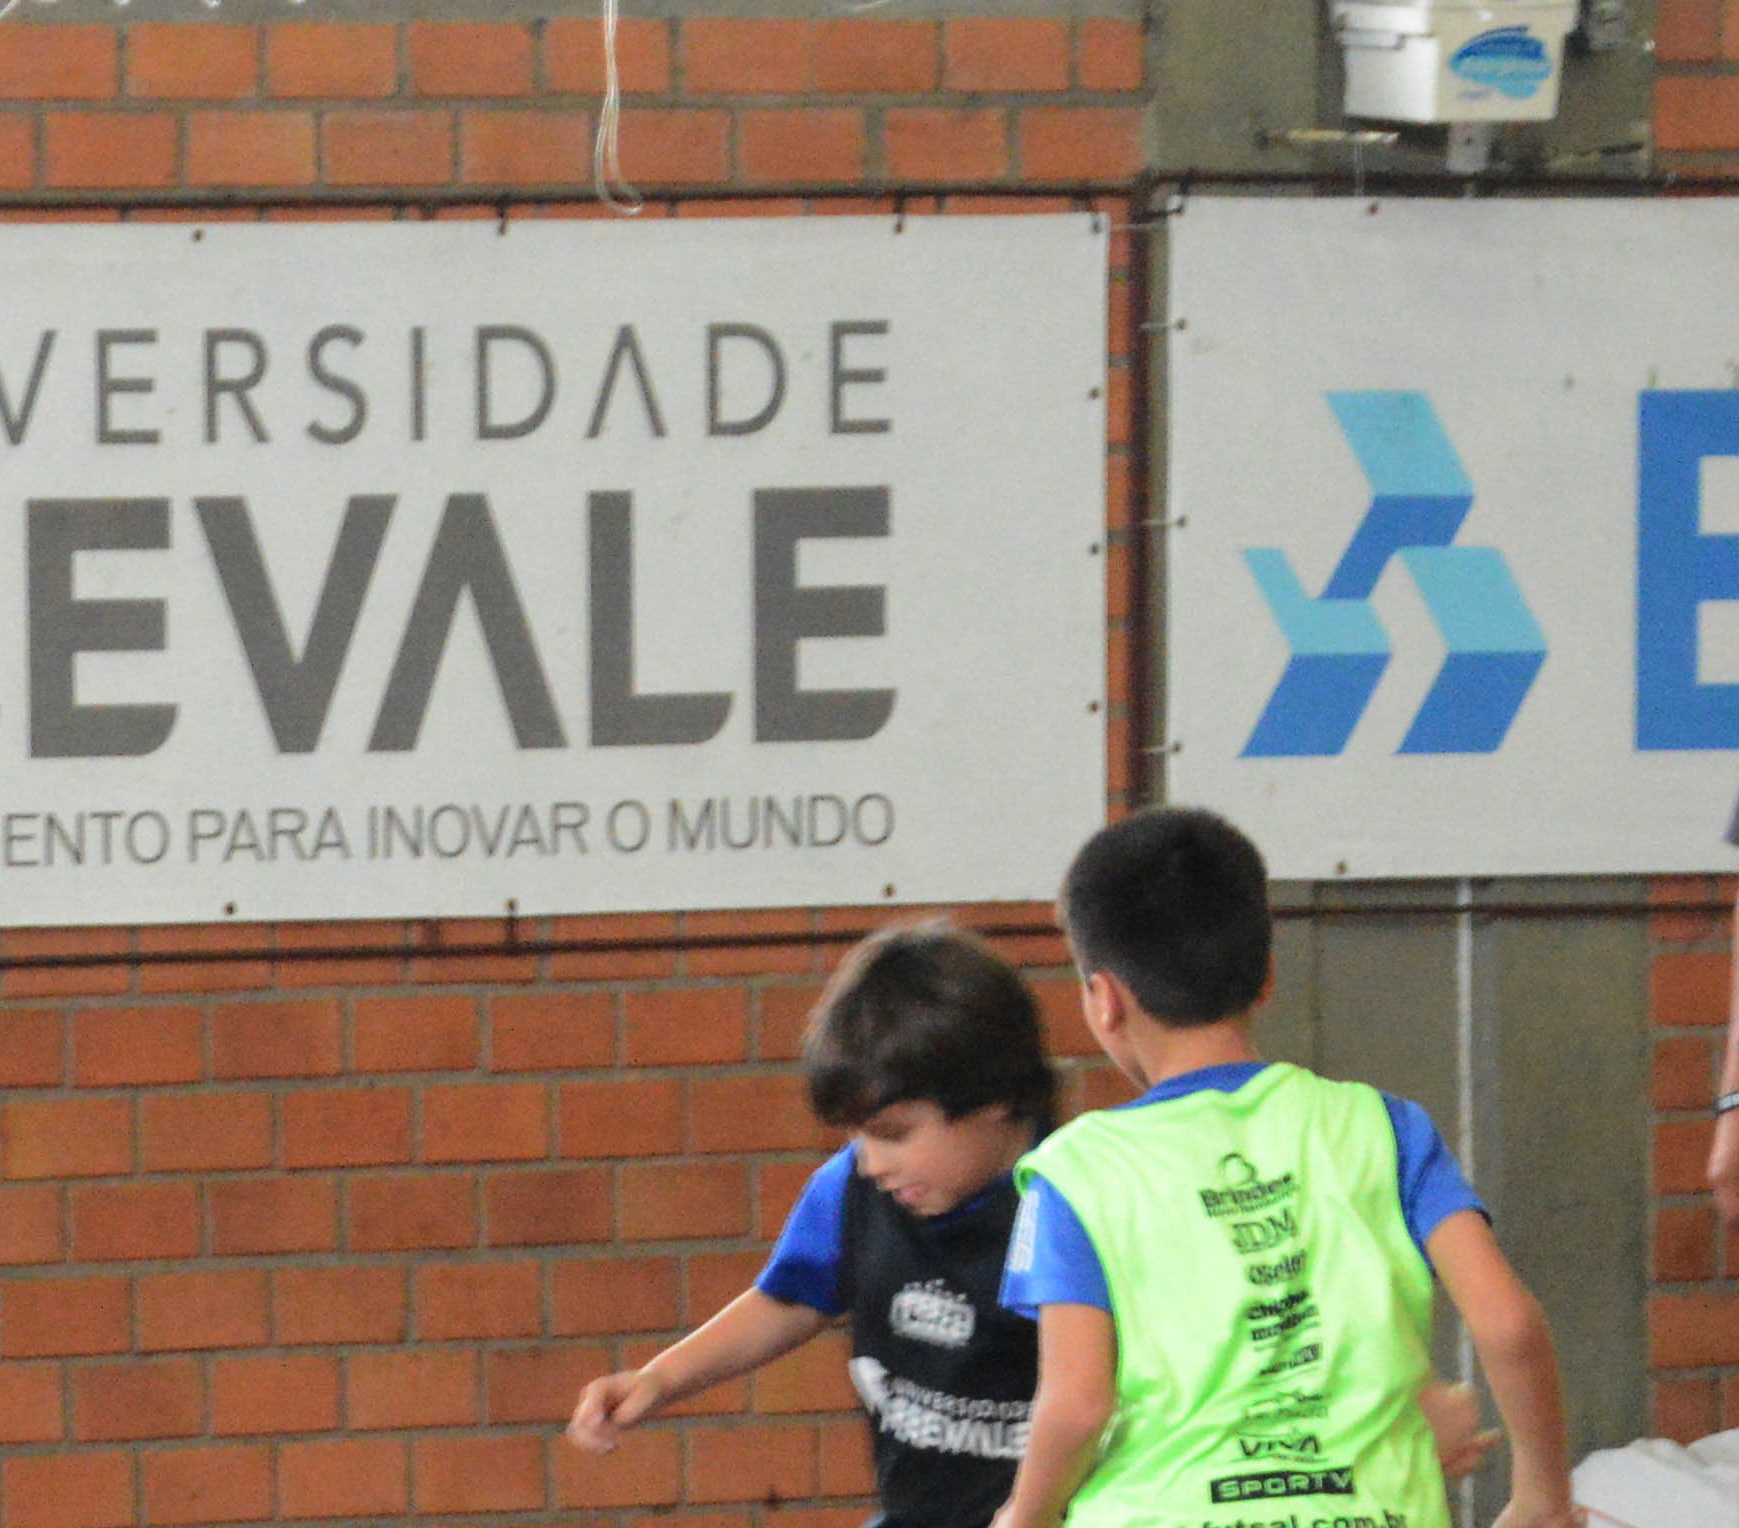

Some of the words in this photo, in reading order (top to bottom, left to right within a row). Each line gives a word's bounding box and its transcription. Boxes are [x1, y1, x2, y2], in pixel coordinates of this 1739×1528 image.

[186, 807, 353, 864] PARA
[367, 799, 593, 861] INOVAR
[606, 798, 653, 855] O
[668, 792, 898, 853] MUNDO
[1199, 1172, 1293, 1208] Brinde
[1216, 1470, 1354, 1500] SPORTV
